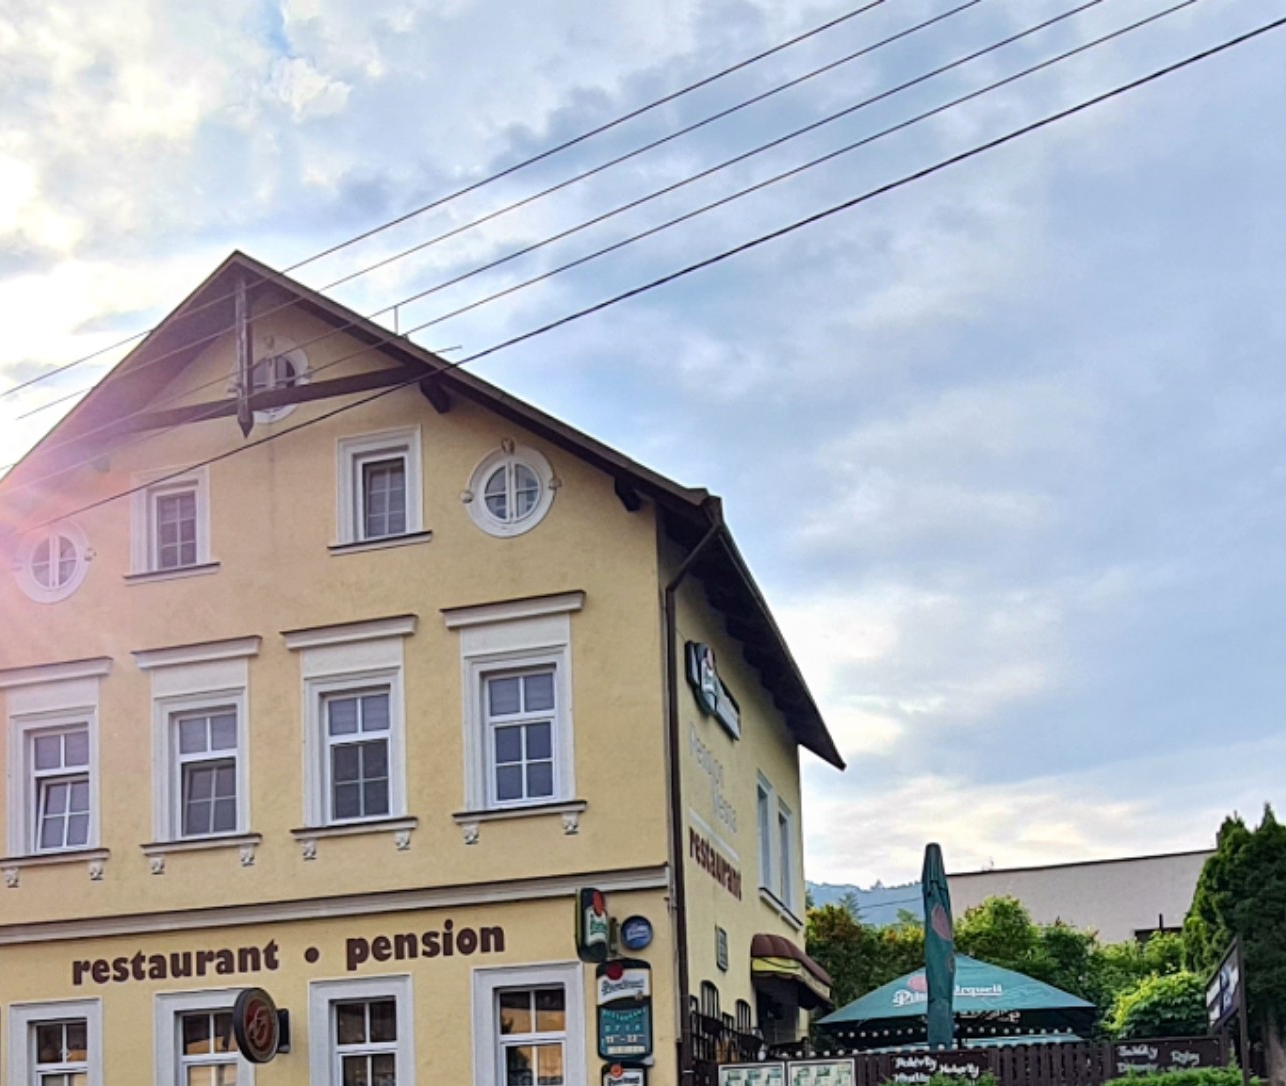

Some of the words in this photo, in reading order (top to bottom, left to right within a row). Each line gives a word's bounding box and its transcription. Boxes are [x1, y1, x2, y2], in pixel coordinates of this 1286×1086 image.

[689, 826, 742, 901] restaurant
[72, 938, 279, 986] restaurant
[345, 918, 506, 972] pension
